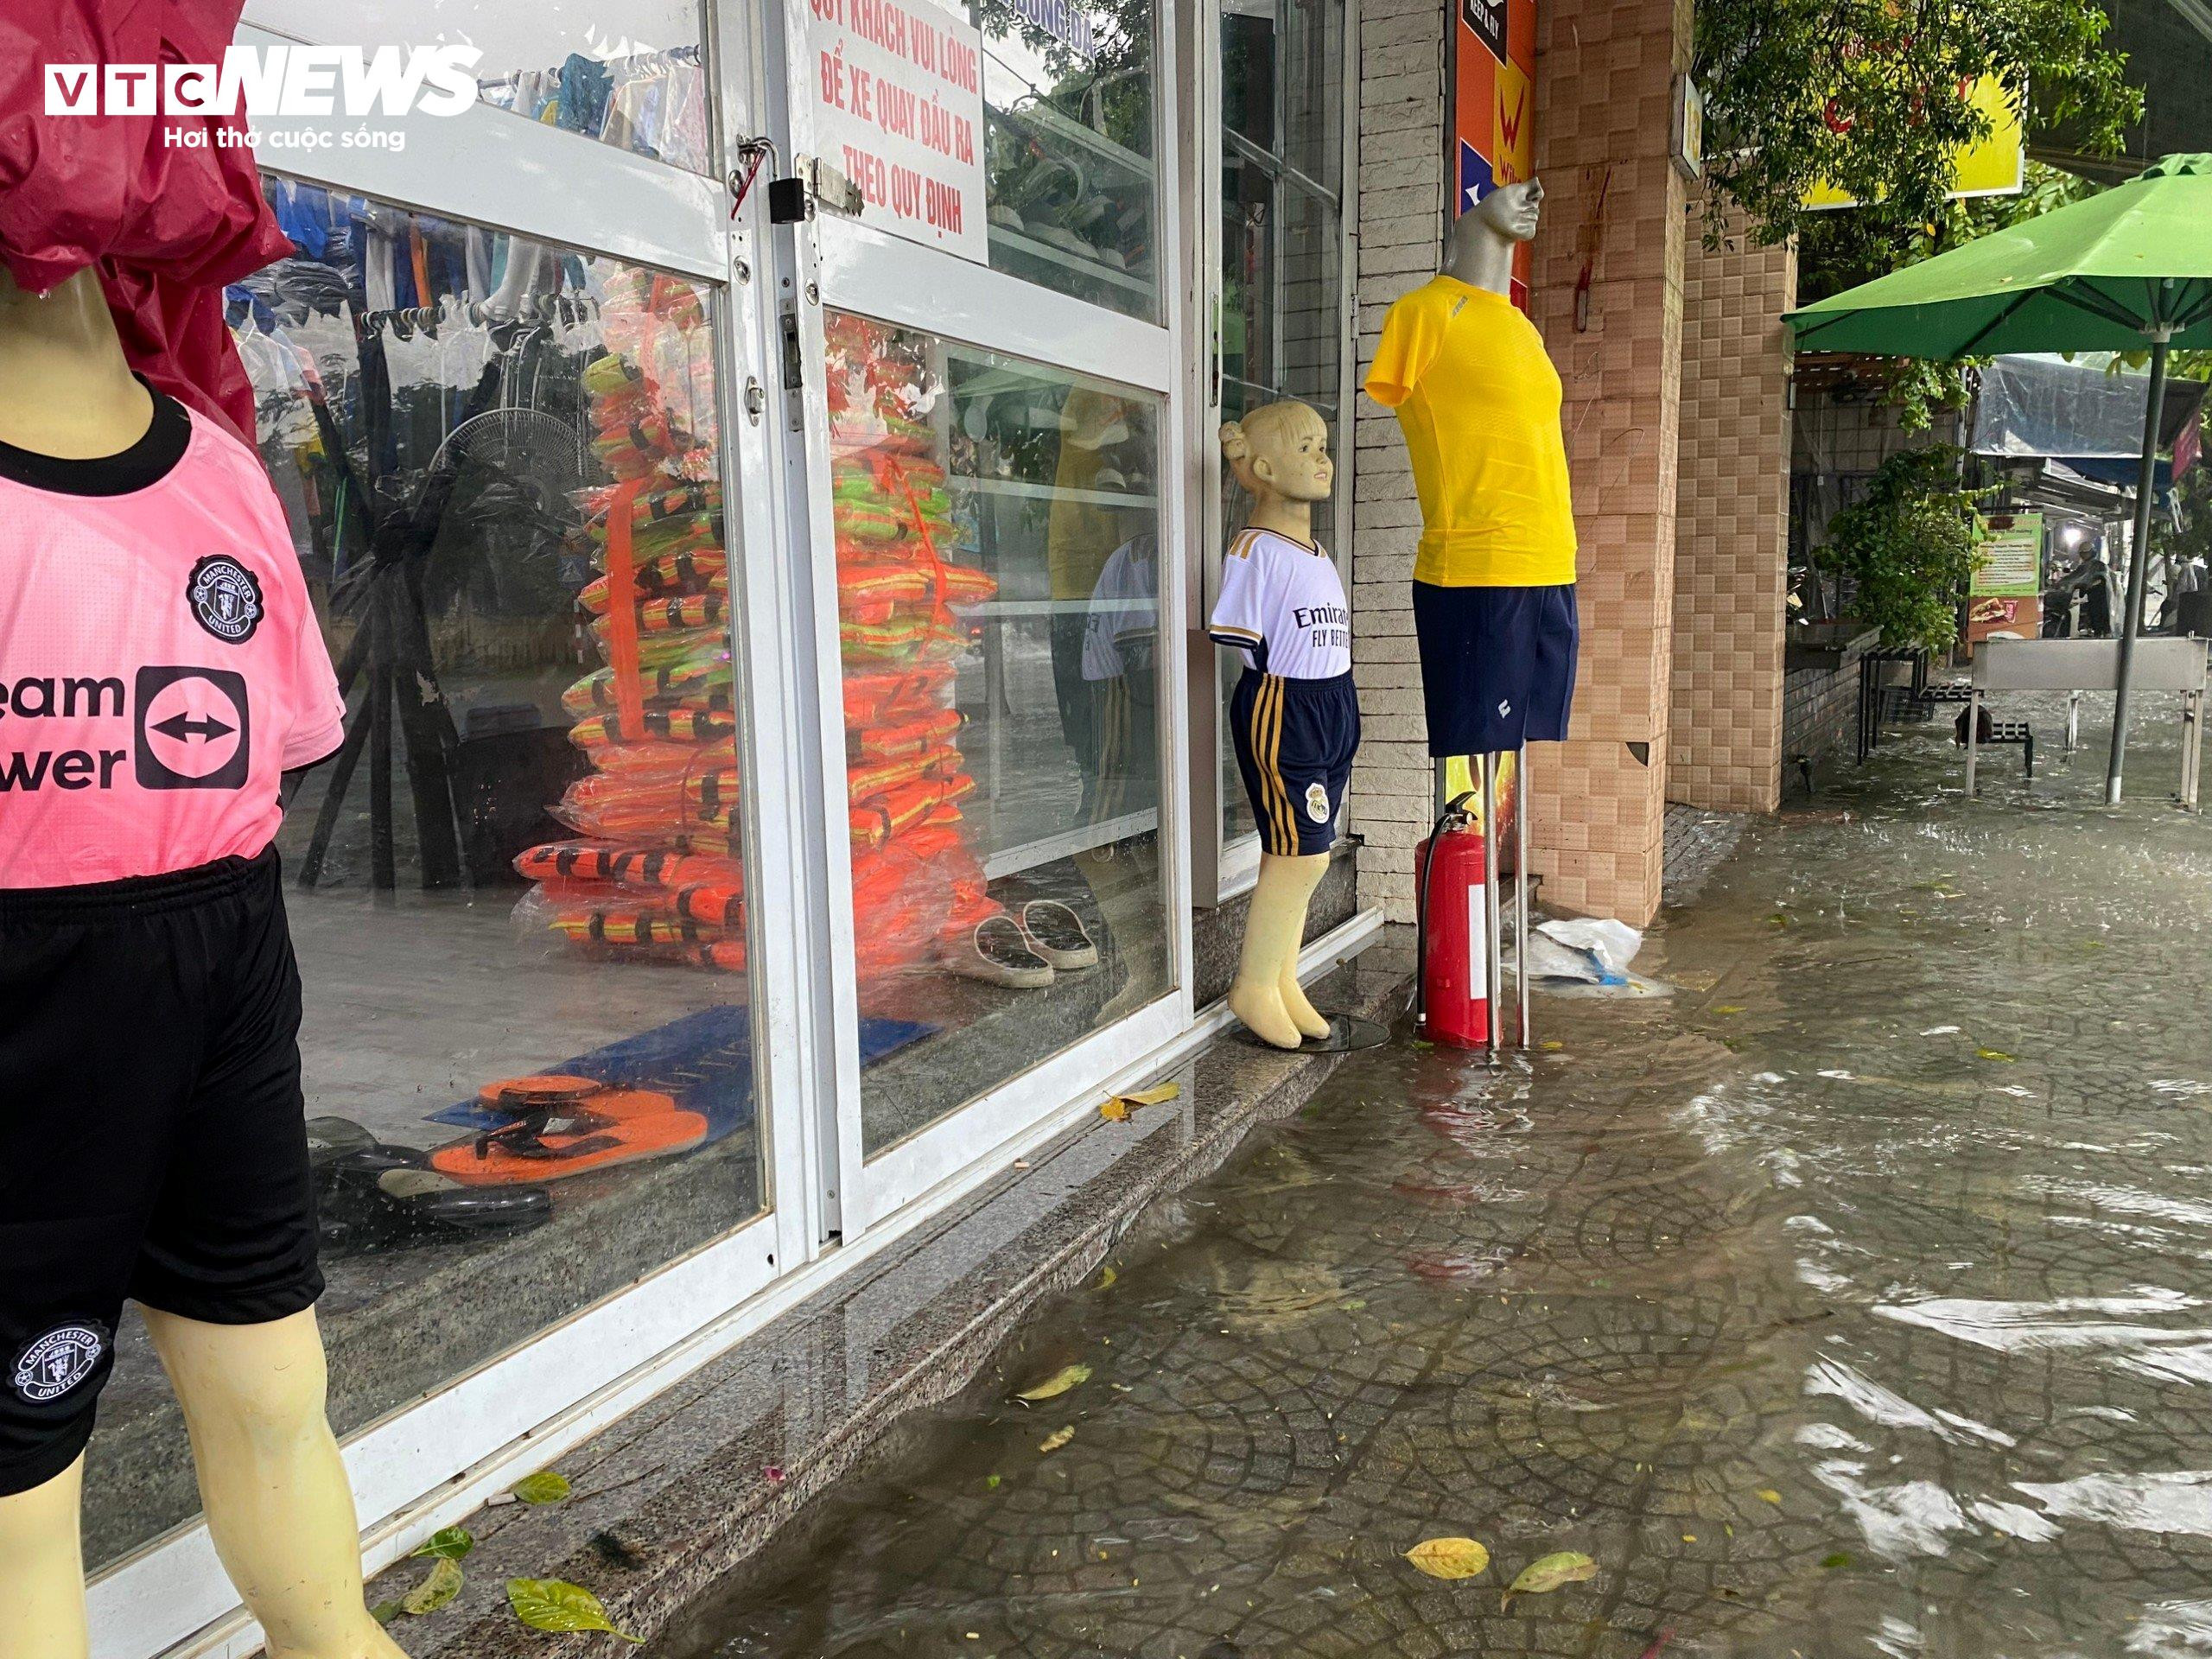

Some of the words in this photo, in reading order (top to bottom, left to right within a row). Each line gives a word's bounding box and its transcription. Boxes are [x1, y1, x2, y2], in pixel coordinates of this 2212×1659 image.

[1490, 15, 1499, 40] FLY
[910, 16, 936, 74] VUI
[939, 26, 977, 94] LÒNG
[820, 37, 845, 110] ĐỂ
[849, 64, 872, 121] XE
[876, 78, 916, 140] QUAY
[920, 88, 951, 156] ĐẦU
[955, 114, 974, 167] RA
[842, 144, 887, 207] THEO
[891, 163, 921, 219] QUY
[925, 177, 963, 239] ĐỊNH
[202, 565, 251, 599] MANCHESTER
[207, 614, 242, 633] UNITED
[1312, 629, 1327, 648] FLY
[25, 1331, 93, 1365] MANCHESTER
[37, 1372, 82, 1397] UNITED
